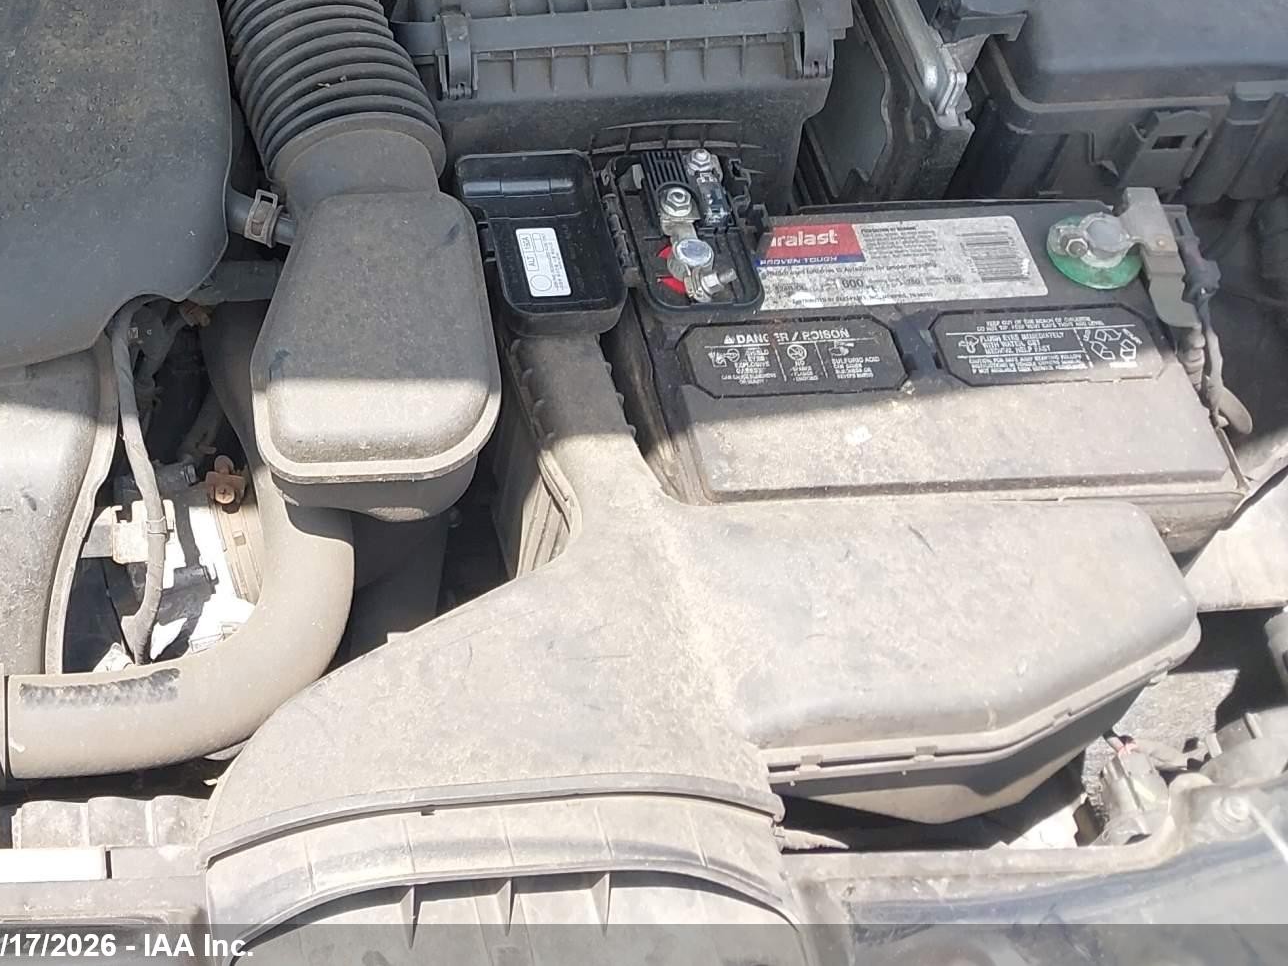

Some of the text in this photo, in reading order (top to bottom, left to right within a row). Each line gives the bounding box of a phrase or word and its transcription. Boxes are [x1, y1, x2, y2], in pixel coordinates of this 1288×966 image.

[759, 255, 838, 267] PROVEN TOUGH
[792, 331, 799, 341] /
[801, 328, 850, 341] POISON
